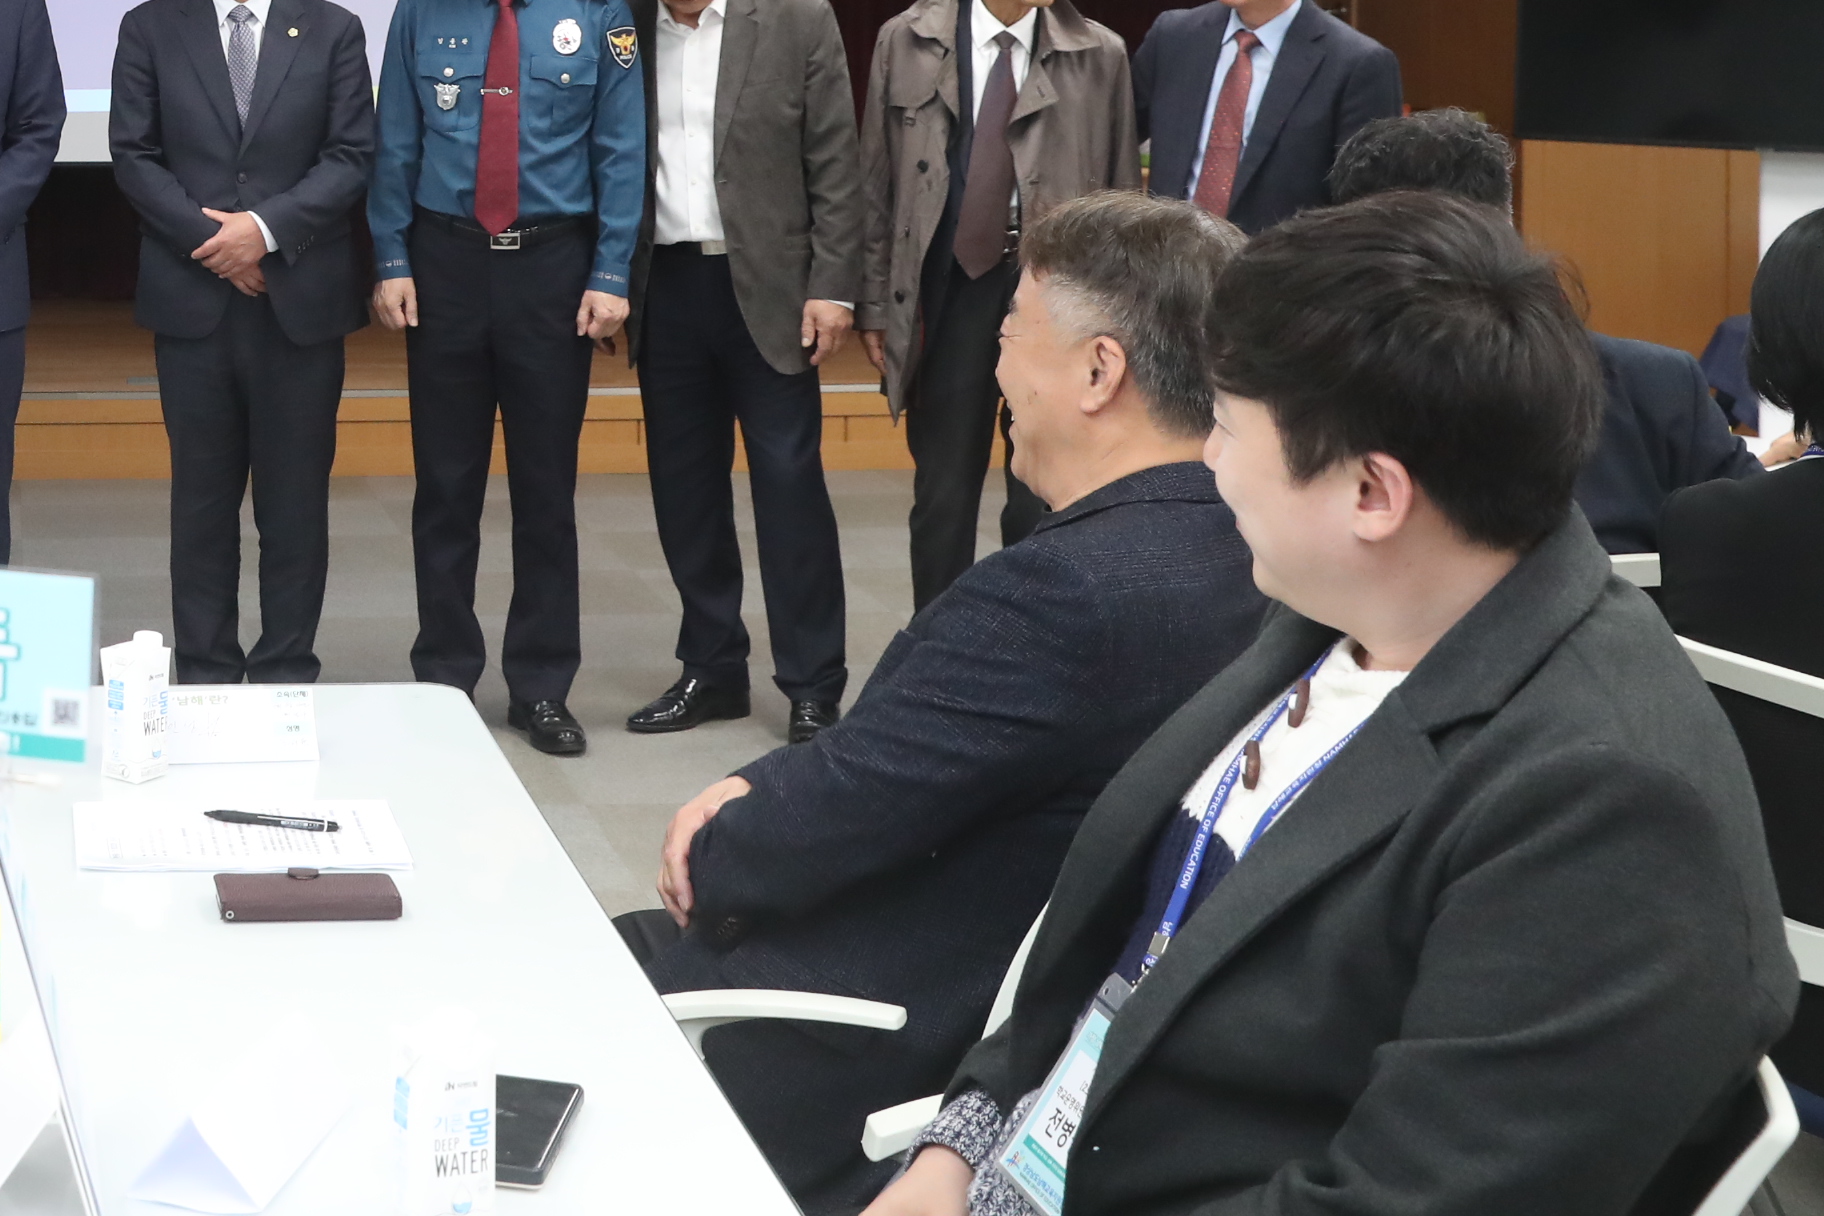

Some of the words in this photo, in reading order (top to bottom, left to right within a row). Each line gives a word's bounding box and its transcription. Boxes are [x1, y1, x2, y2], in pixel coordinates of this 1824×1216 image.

[1229, 749, 1248, 785] AMHAE
[1209, 783, 1229, 820] OFFICE
[1202, 818, 1212, 832] OF
[1180, 832, 1208, 890] EDUCATION
[434, 1137, 460, 1152] DEEP
[434, 1148, 489, 1178] WATER
